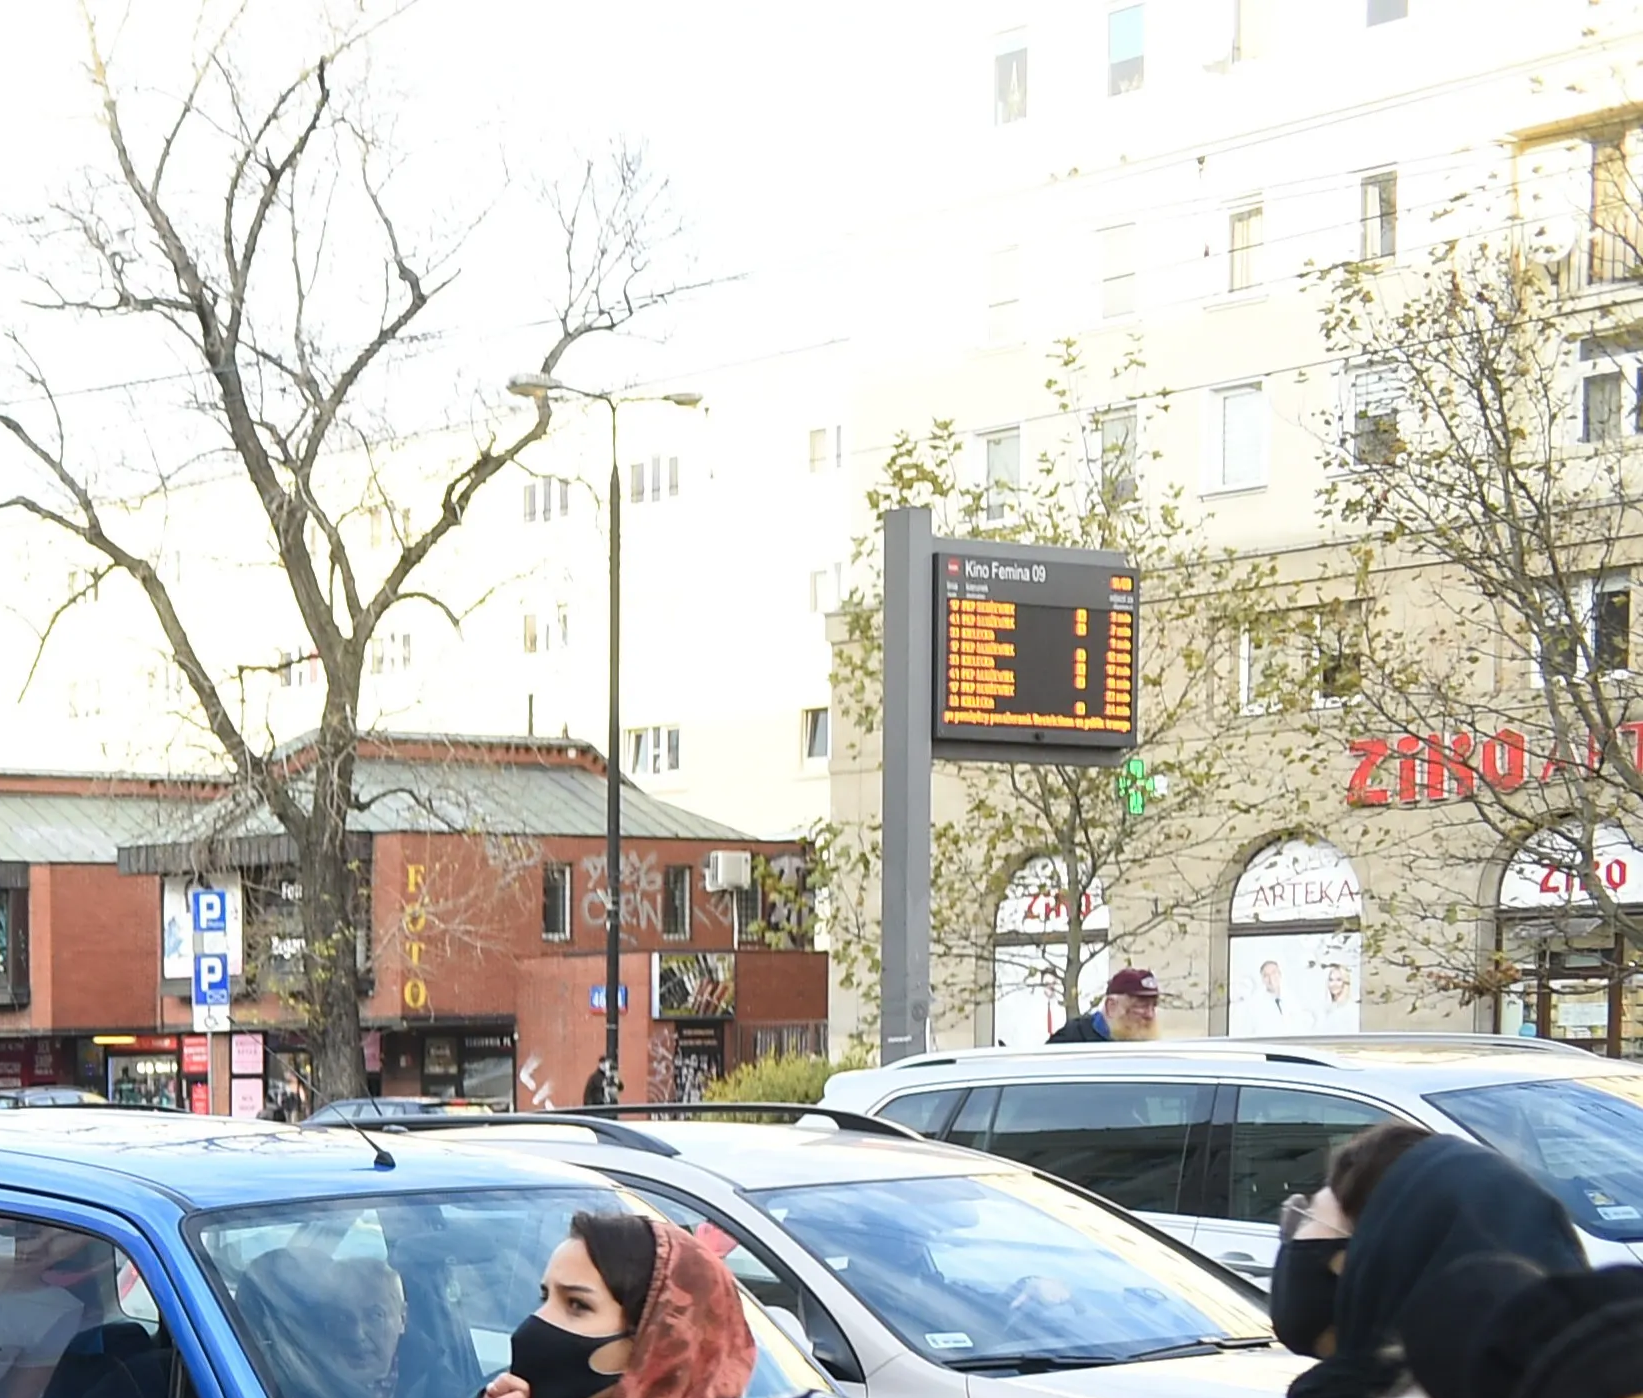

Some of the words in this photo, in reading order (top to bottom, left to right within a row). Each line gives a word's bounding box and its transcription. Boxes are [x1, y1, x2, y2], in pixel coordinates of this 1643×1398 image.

[965, 560, 989, 579] Kino
[991, 562, 1030, 582] Femina
[1032, 565, 1046, 583] 09
